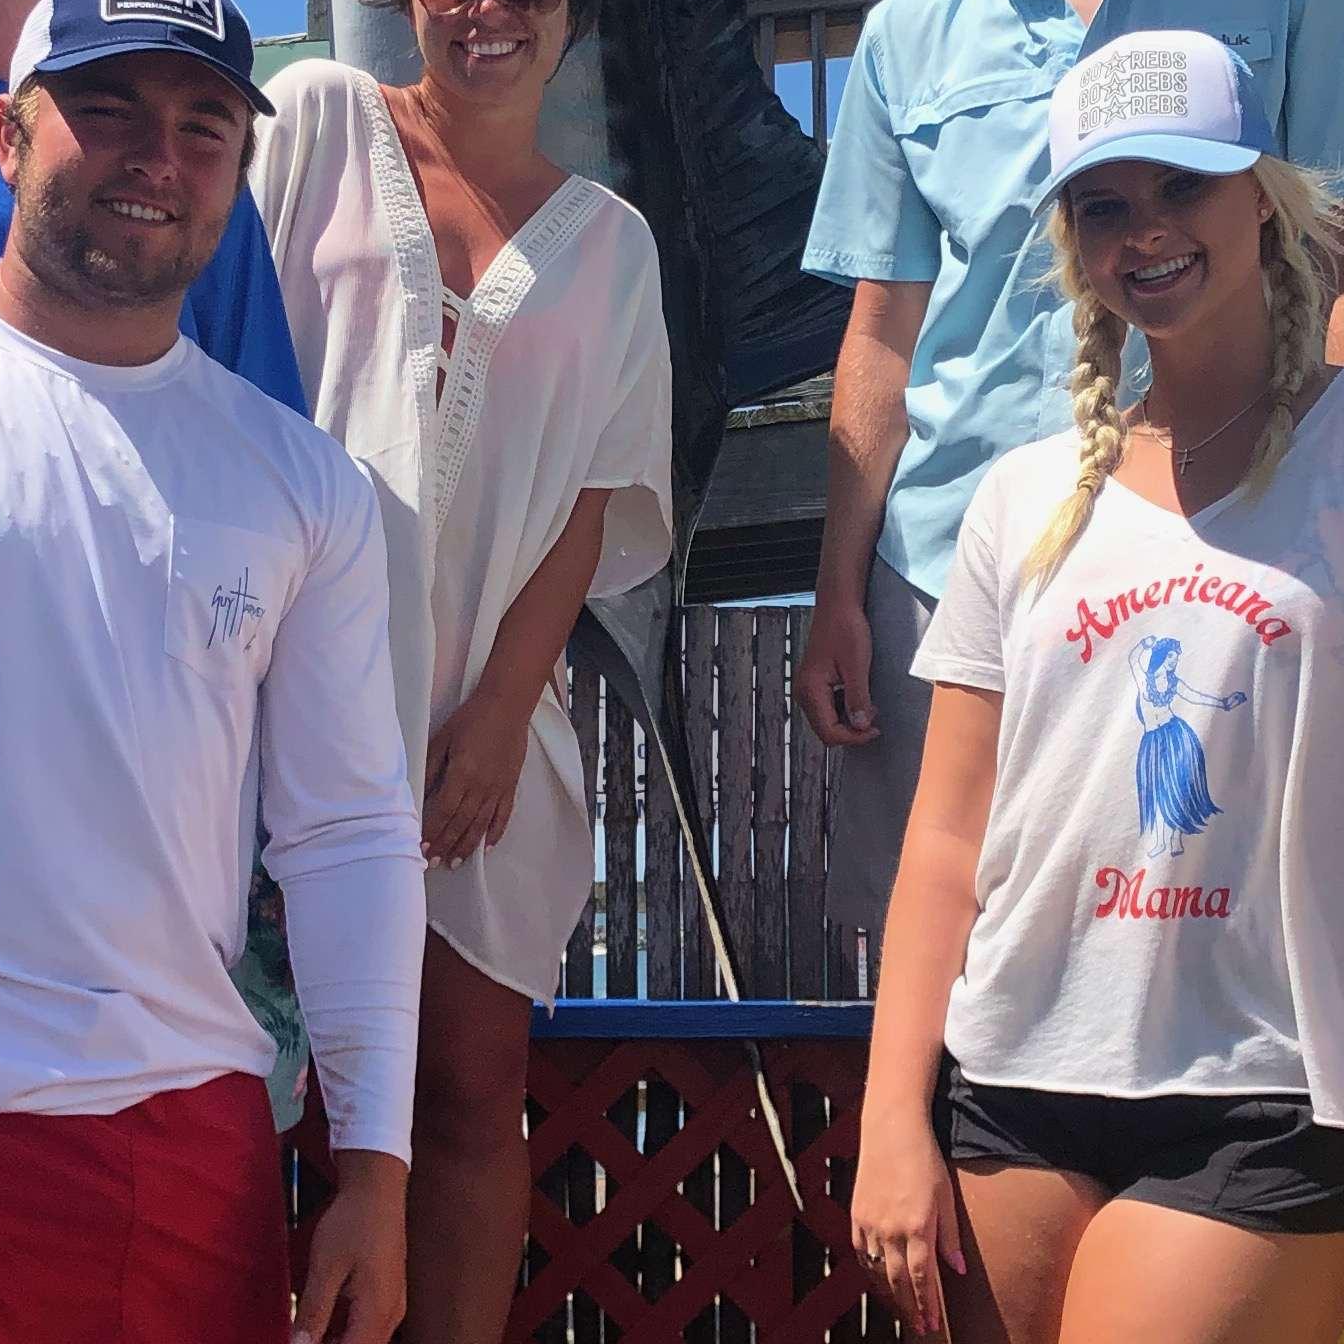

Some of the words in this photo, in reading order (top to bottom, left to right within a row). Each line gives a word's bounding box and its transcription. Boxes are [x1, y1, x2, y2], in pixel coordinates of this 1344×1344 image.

[1129, 50, 1187, 70] REBS
[1078, 83, 1102, 111] GO
[1129, 72, 1188, 93] REBS
[1078, 106, 1102, 133] GO
[1130, 95, 1188, 116] REBS
[1066, 563, 1292, 664] Americana
[1095, 867, 1231, 919] Mama
